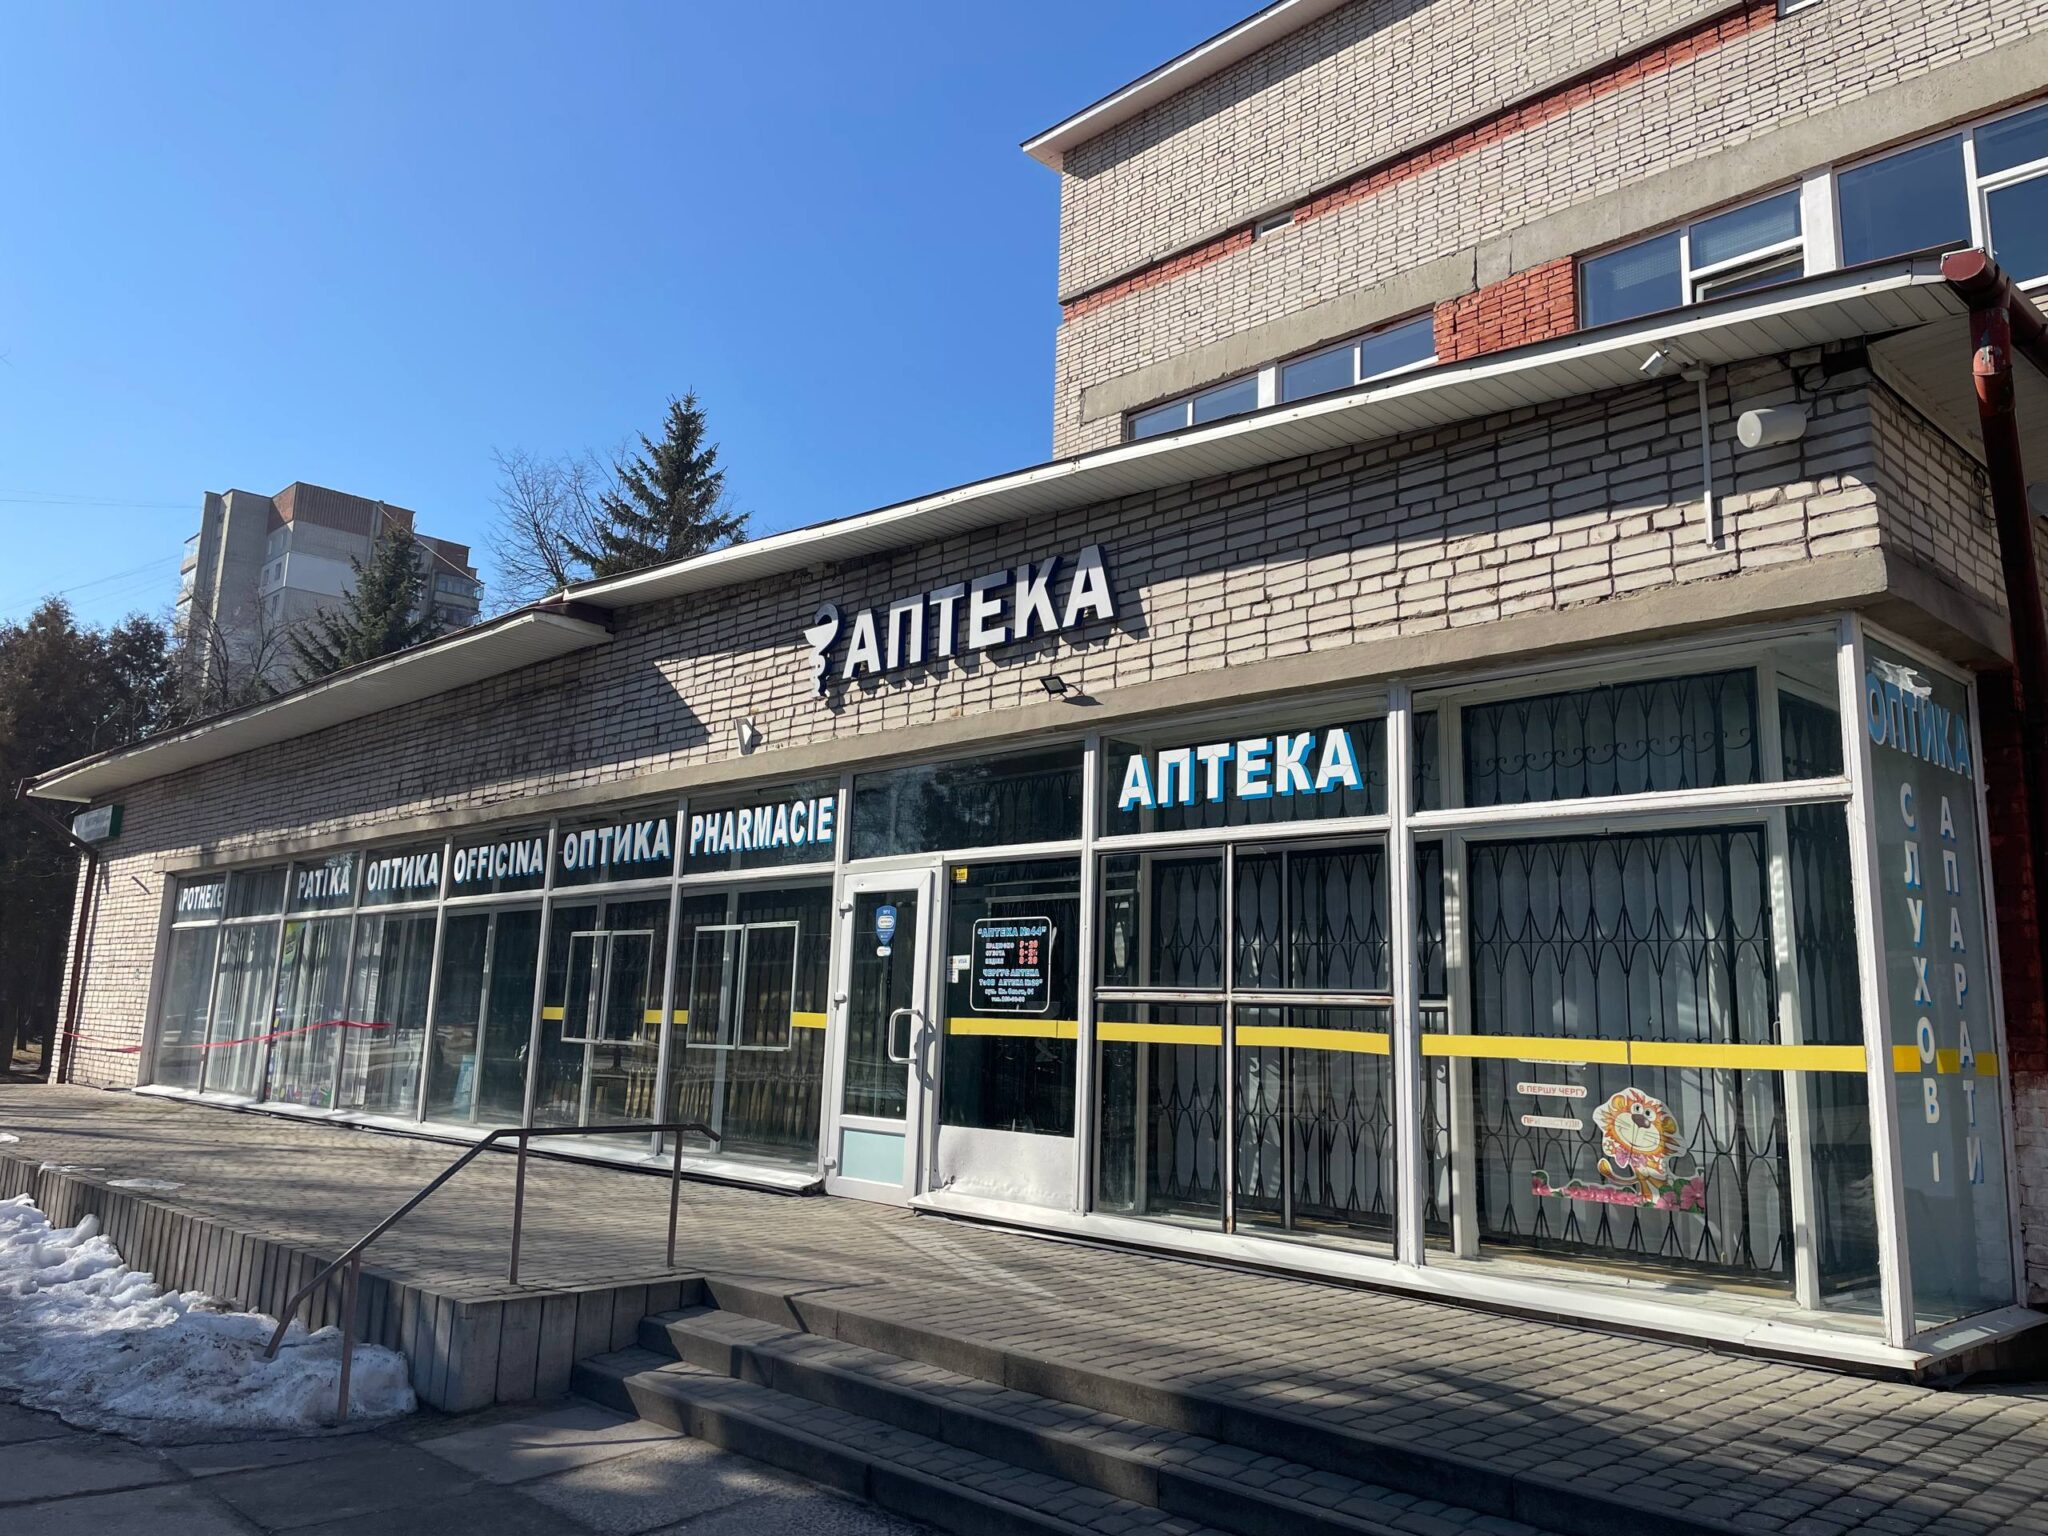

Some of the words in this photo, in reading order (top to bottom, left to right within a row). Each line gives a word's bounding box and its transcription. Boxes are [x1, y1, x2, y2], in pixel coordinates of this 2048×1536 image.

[842, 544, 1115, 679] АПТЕКА
[1866, 672, 1972, 779] ОПТИКА
[1118, 728, 1362, 811] АПТЕКА
[563, 818, 672, 871] ОПТИКА
[689, 797, 834, 856] PHARMACIE
[297, 865, 350, 899] PATIKA
[367, 852, 439, 891] ОПТИКА
[454, 838, 545, 884] OFFICINA
[1900, 782, 1942, 1182] СЛУХОВІ
[1940, 796, 1984, 1184] АПАРАТИ
[1519, 1085, 1525, 1093] В
[1527, 1086, 1557, 1094] ПЕРШУ
[1558, 1087, 1586, 1097] ЧЕРГУ
